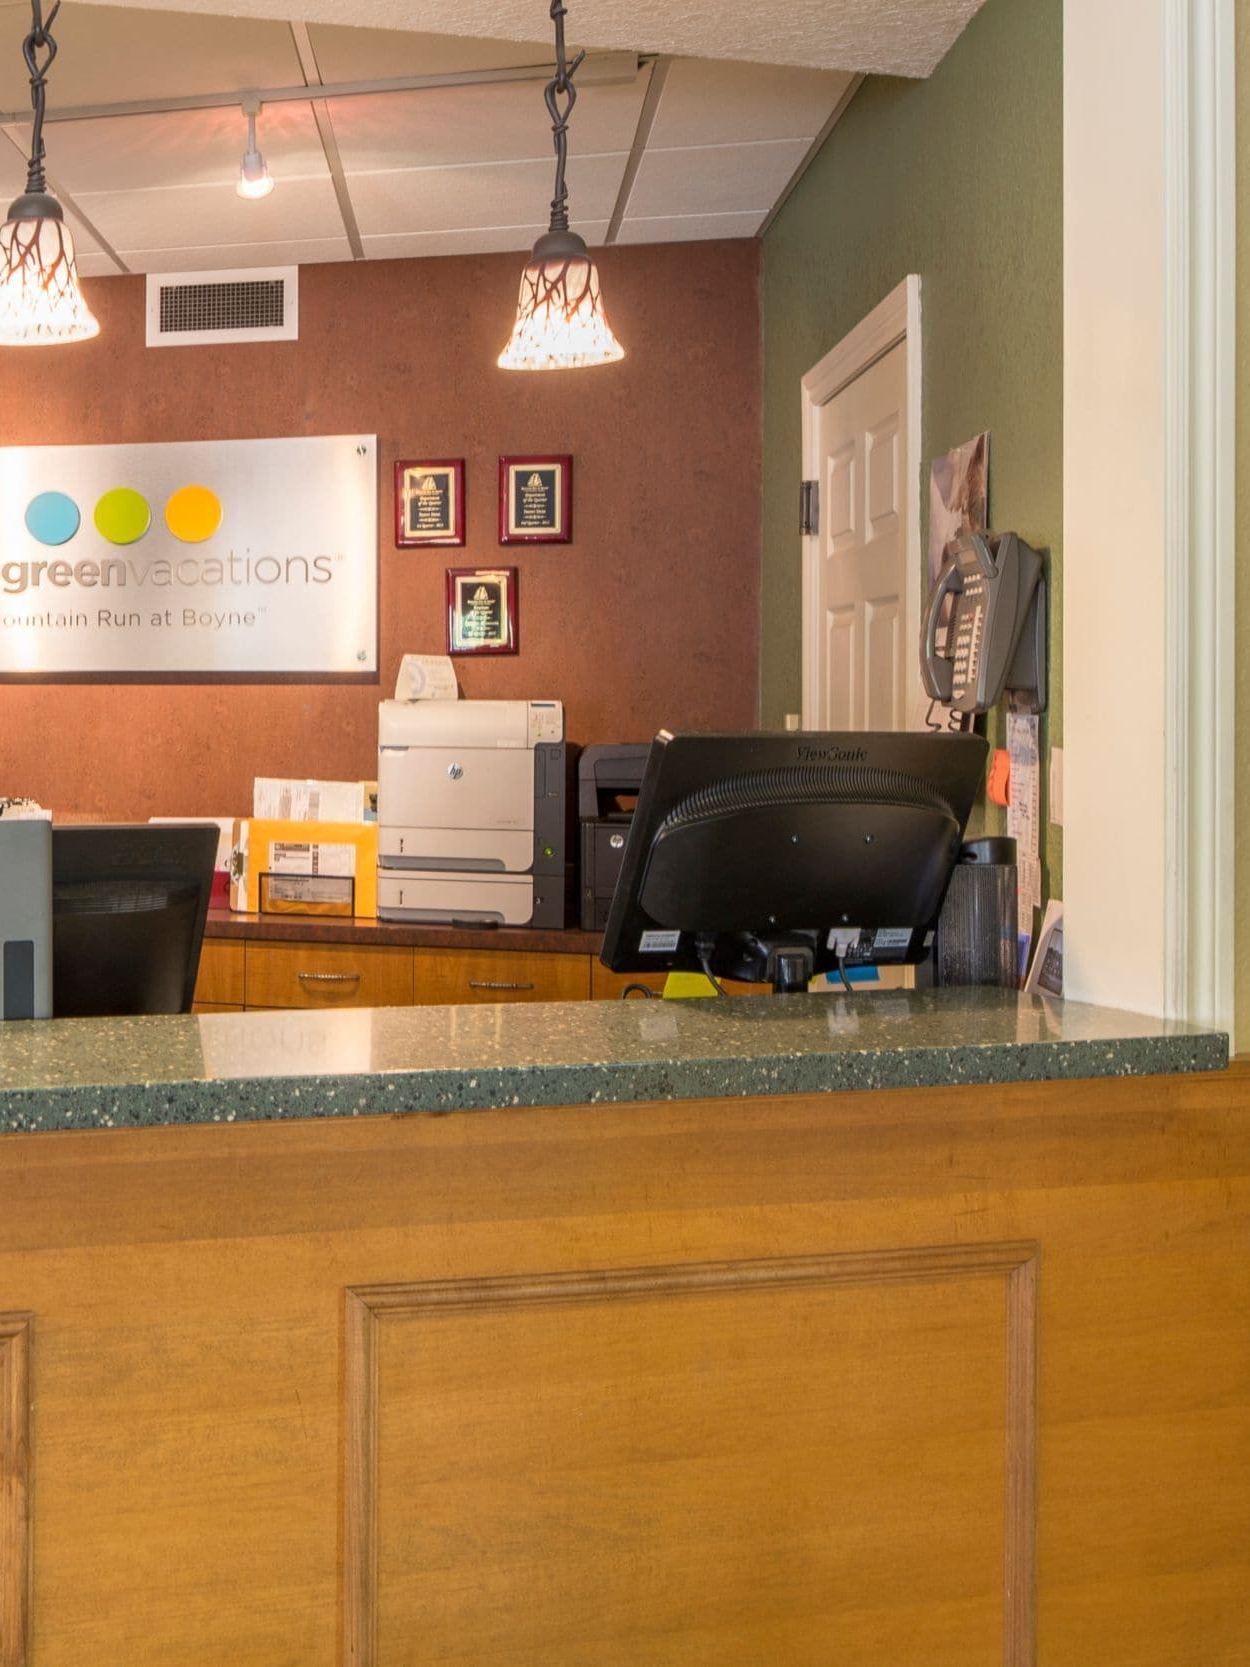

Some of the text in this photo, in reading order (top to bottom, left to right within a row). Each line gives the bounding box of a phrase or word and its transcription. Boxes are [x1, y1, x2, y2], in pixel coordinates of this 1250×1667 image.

[97, 609, 141, 628] Run
[150, 609, 172, 628] at
[181, 608, 256, 629] Boyne
[796, 746, 868, 761] ViewSonic
